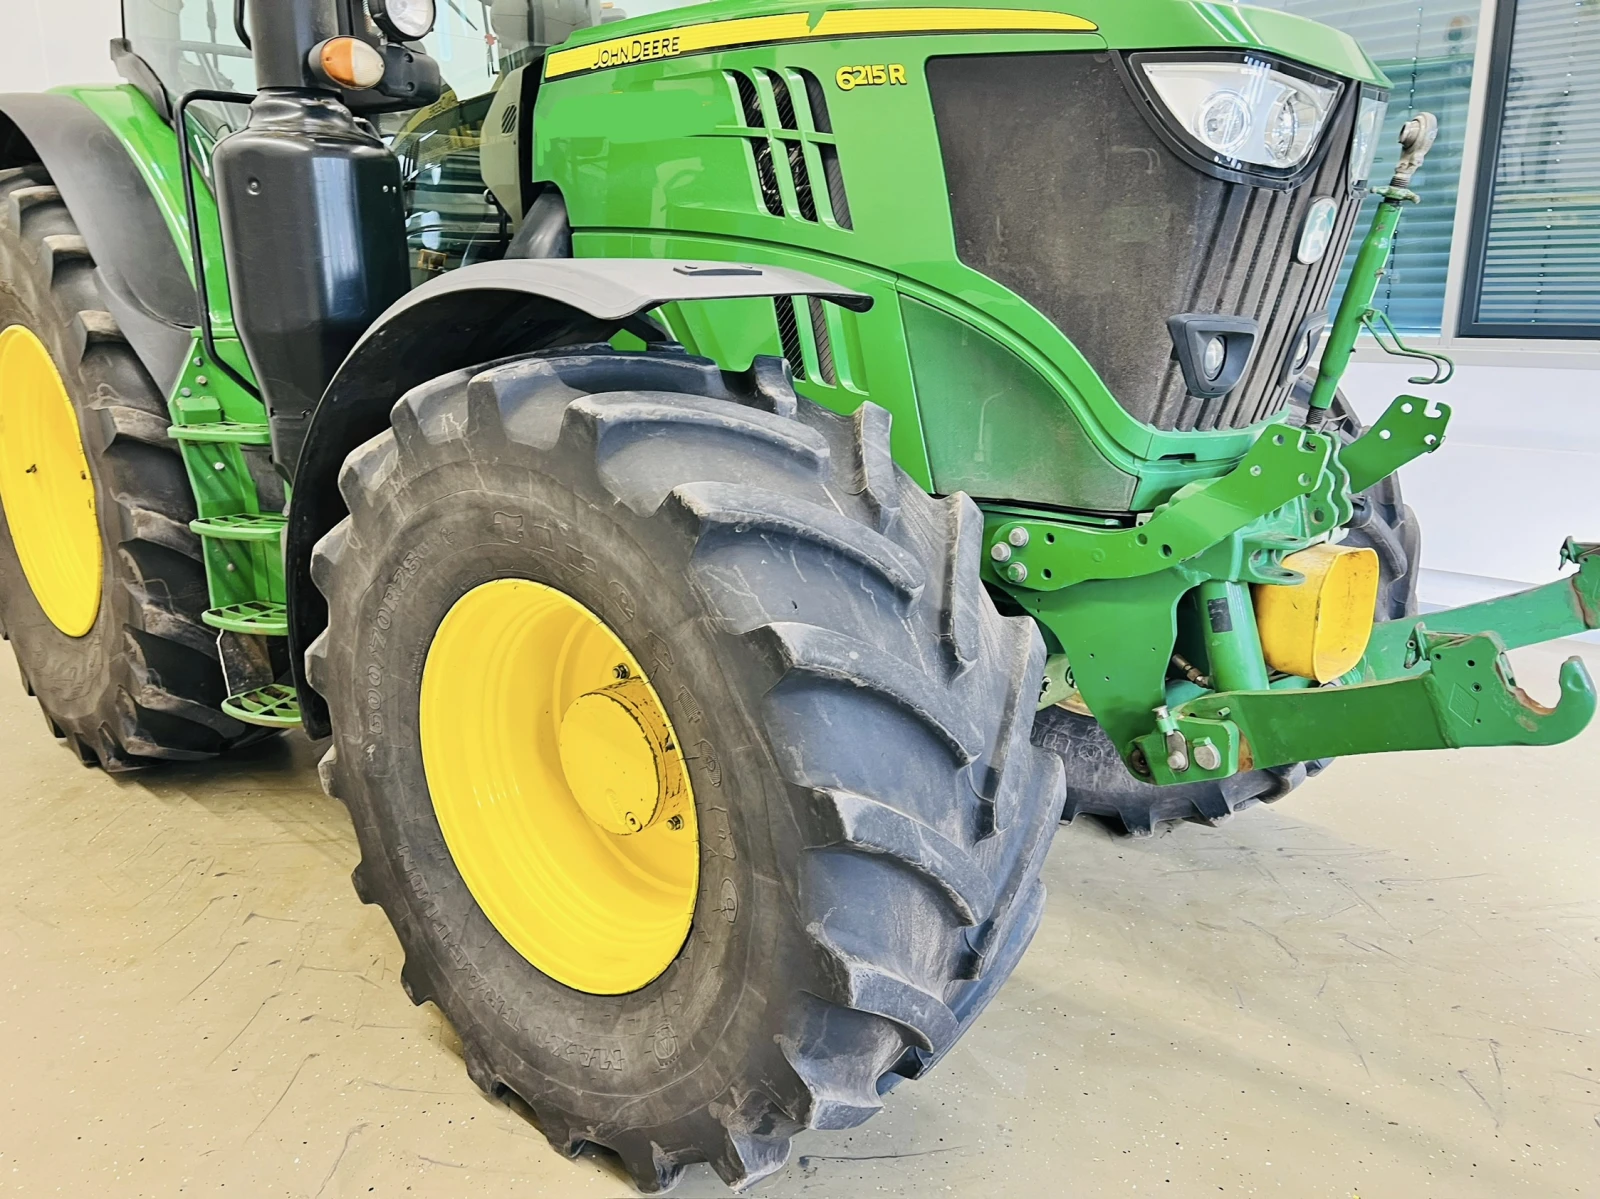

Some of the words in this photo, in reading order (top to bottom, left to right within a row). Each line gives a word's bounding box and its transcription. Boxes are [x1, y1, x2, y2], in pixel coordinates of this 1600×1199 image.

[592, 45, 629, 67] JOHN
[631, 36, 680, 60] DEERE
[835, 65, 887, 91] 6215
